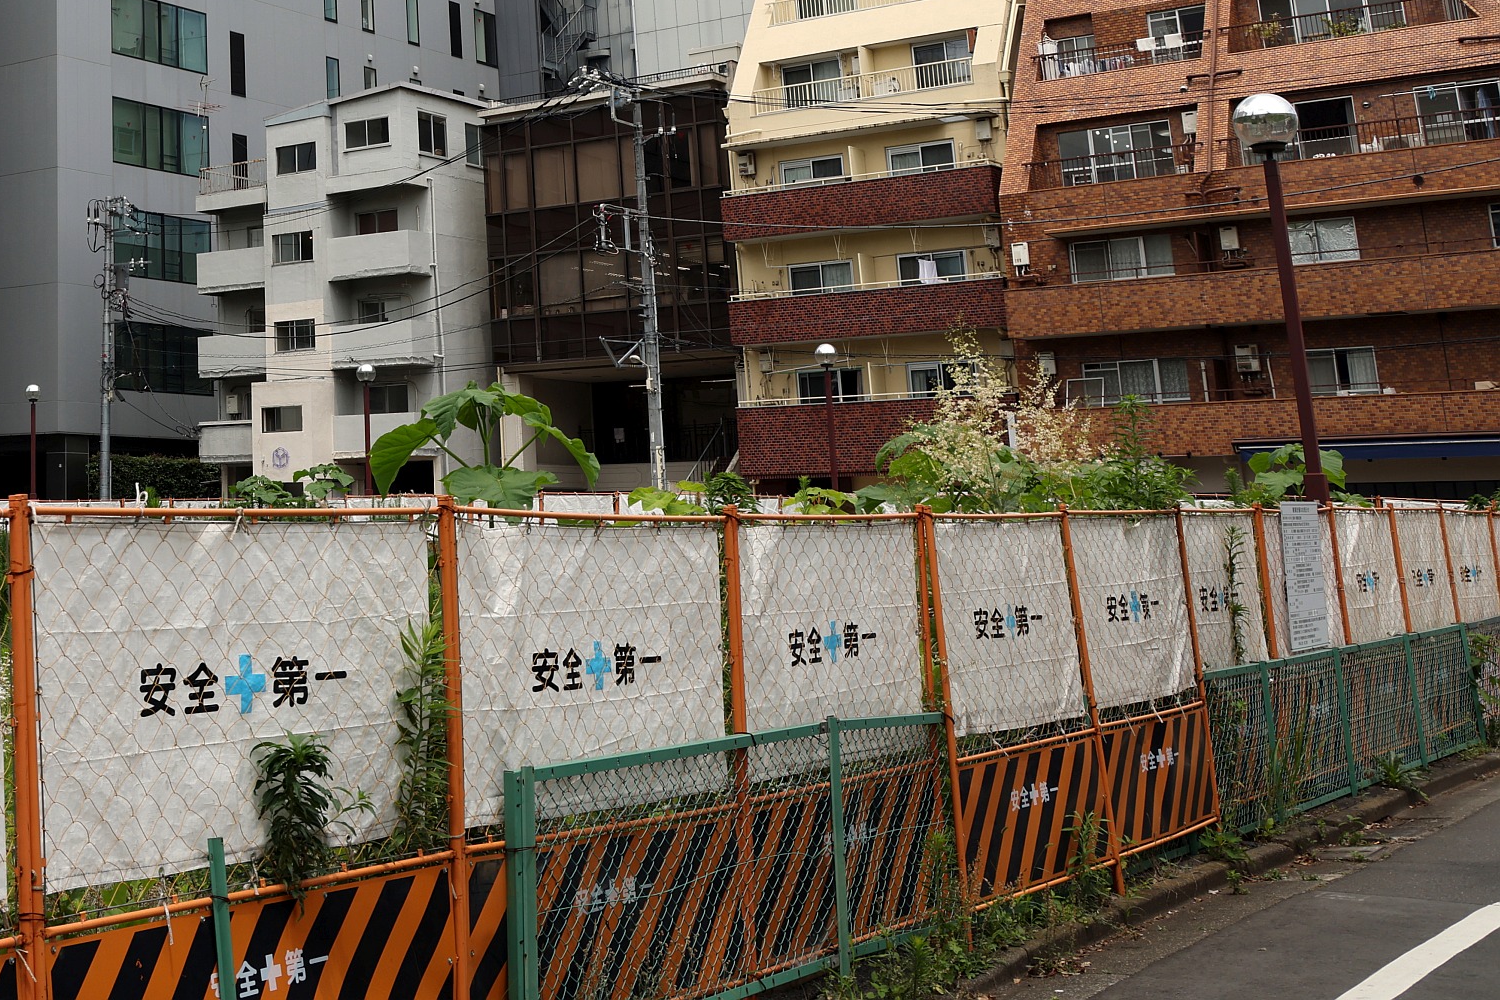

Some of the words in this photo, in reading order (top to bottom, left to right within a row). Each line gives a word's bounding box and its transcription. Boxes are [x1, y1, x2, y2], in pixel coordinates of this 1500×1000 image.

[974, 605, 1043, 640] 安全第一
[789, 621, 877, 667] 安全第一
[139, 656, 348, 717] 安全第一
[532, 643, 662, 693] 安全第一
[1140, 747, 1179, 773] 安全第一
[1011, 781, 1059, 812] 安全第一
